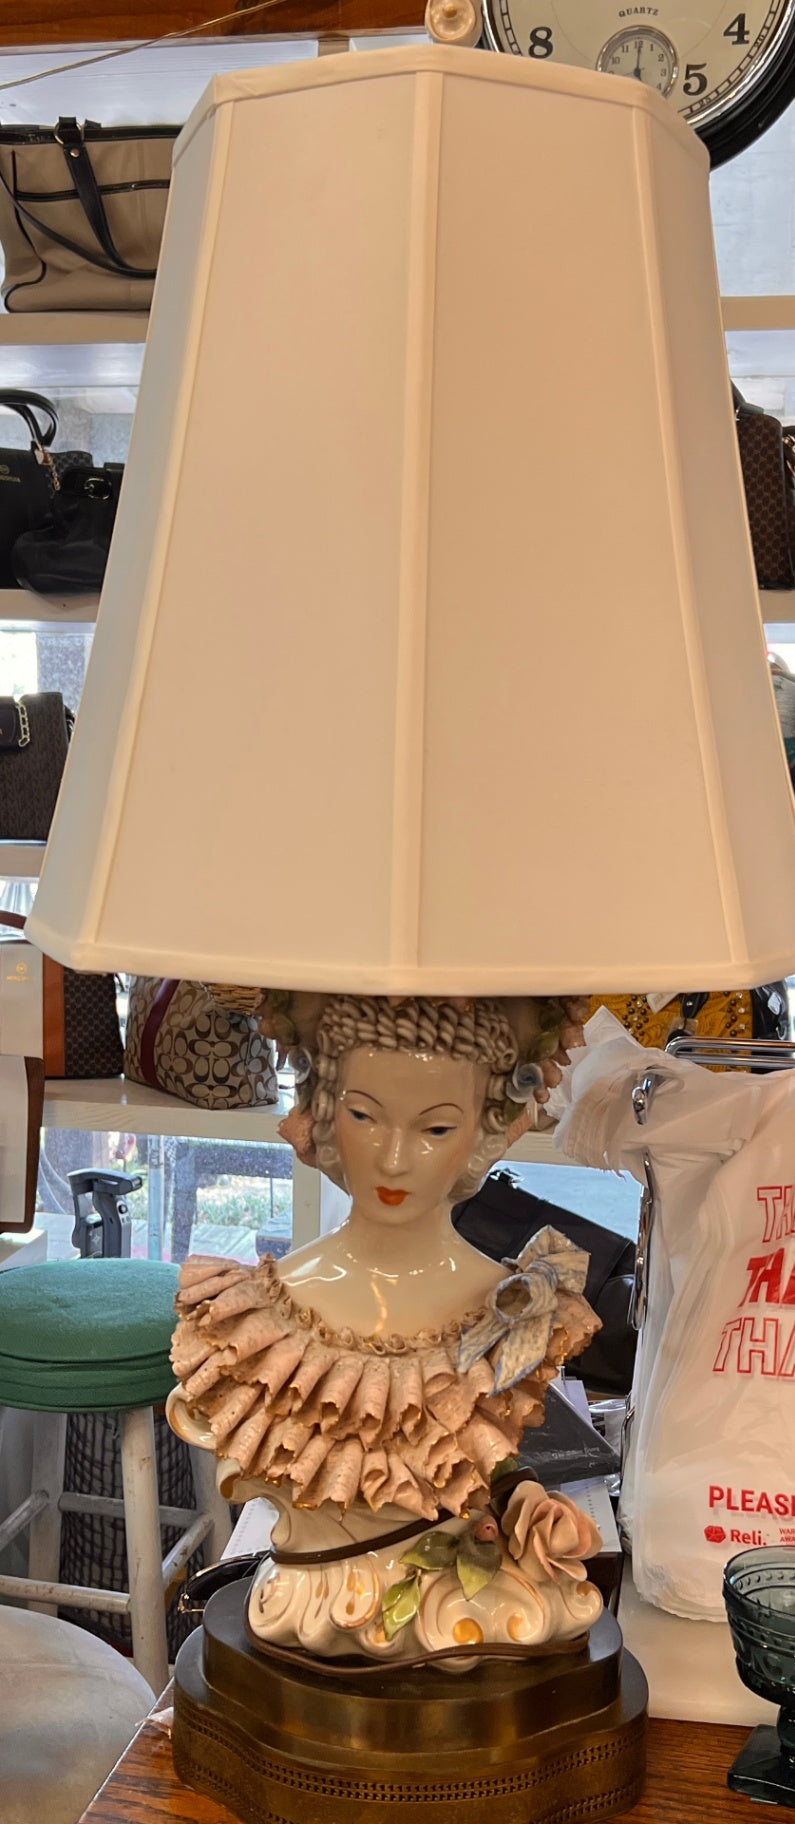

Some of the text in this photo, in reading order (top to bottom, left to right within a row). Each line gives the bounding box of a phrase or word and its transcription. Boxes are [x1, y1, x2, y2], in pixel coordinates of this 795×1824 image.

[618, 6, 659, 17] QUARTZ
[723, 13, 750, 45] 4
[528, 26, 553, 59] 8
[634, 40, 644, 49] 12
[650, 43, 655, 52] 1
[622, 44, 629, 53] 11
[612, 56, 620, 65] 10
[657, 53, 664, 62] 2
[661, 68, 667, 77] 3
[683, 63, 708, 96] 5
[757, 1185, 795, 1243] TH
[730, 1529, 767, 1546] Reli.
